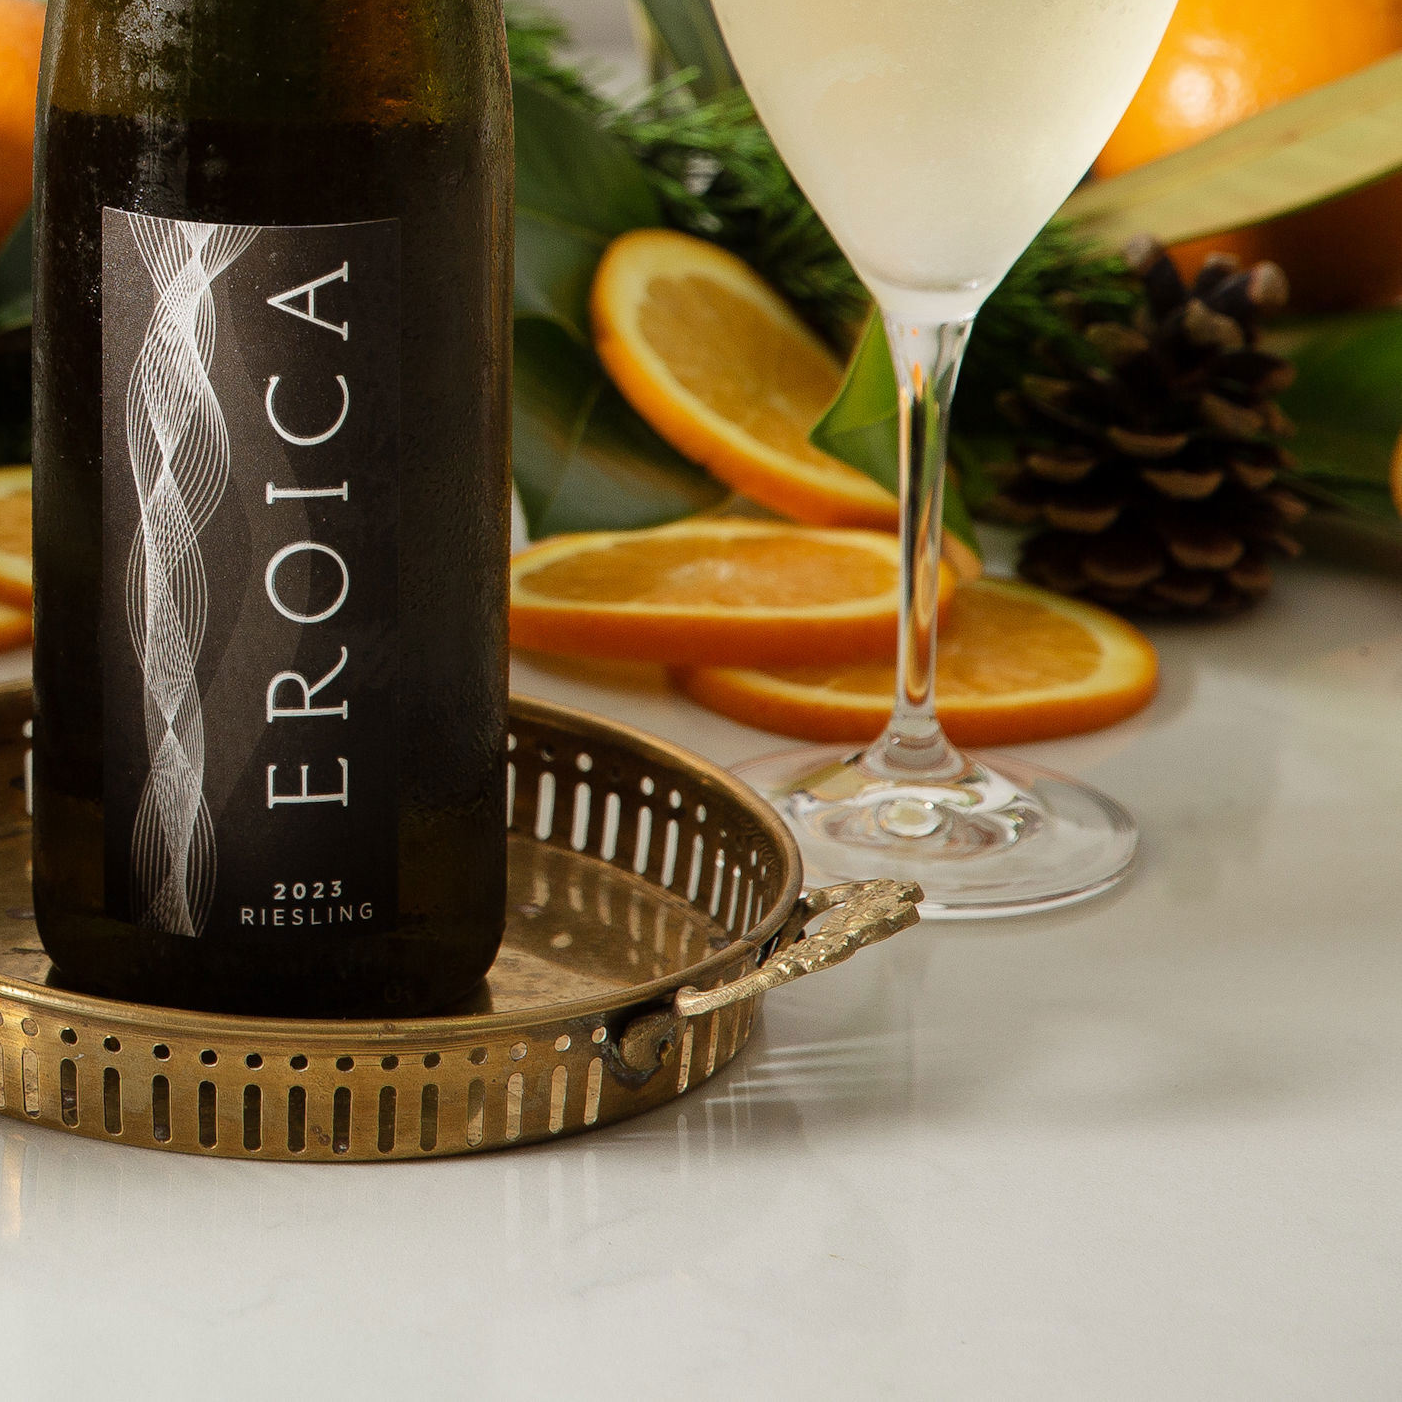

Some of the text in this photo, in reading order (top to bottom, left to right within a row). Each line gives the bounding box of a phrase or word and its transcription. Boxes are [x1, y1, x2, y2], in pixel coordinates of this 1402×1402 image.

[265, 261, 350, 809] EROICA
[273, 880, 343, 900] 2023
[240, 902, 373, 926] RIESLING
